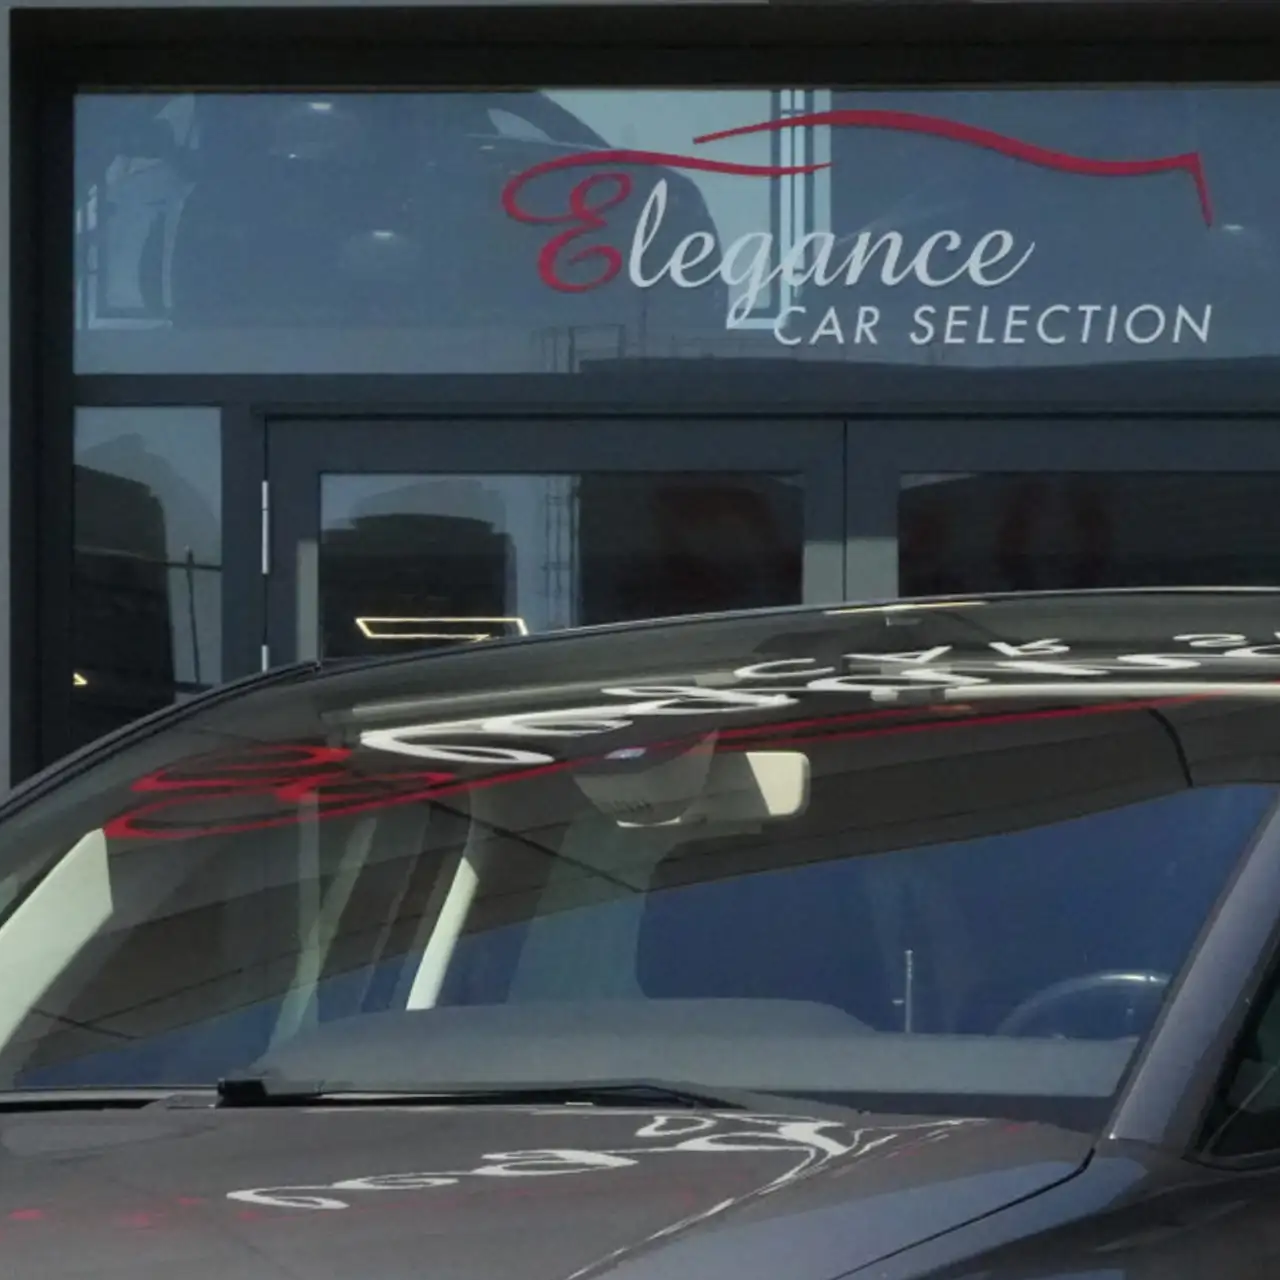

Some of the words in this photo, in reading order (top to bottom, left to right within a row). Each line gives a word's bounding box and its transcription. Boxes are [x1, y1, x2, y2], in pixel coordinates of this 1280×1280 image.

[502, 149, 1036, 329] Elegance
[772, 304, 881, 346] CAR
[909, 303, 1214, 345] SELECTION
